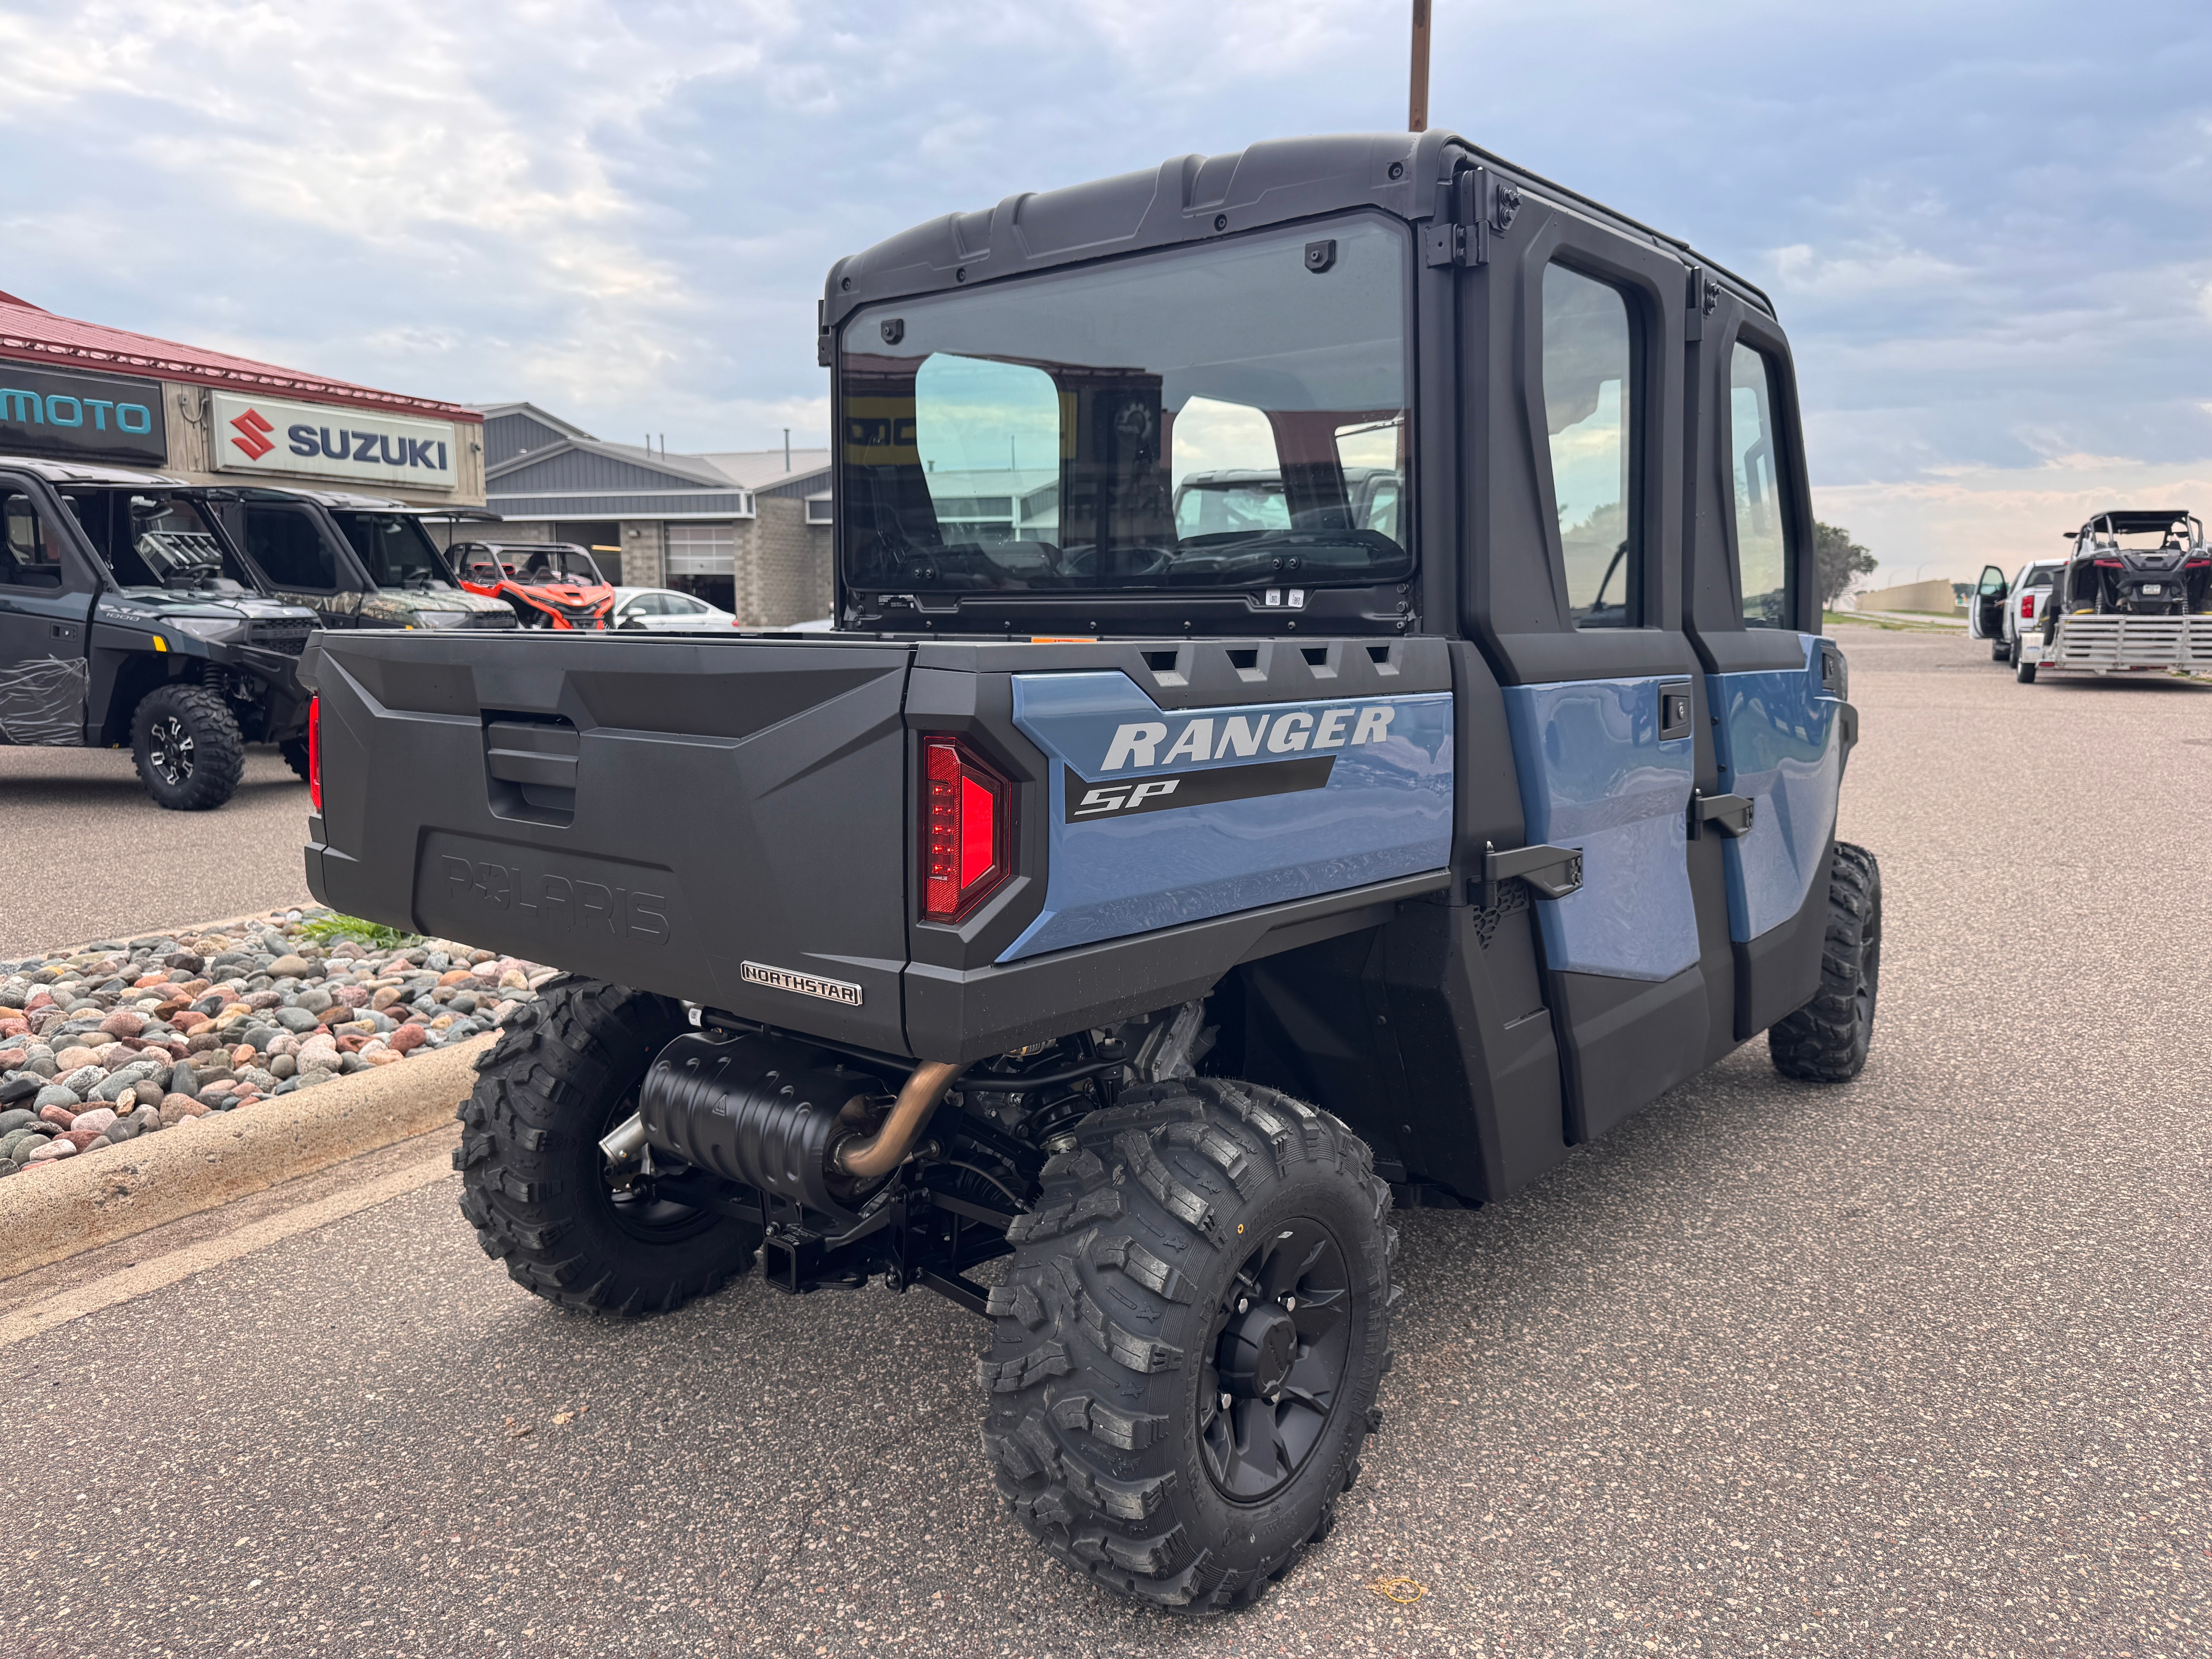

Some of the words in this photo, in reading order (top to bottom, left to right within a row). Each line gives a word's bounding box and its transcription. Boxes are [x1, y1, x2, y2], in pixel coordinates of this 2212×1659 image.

[0, 388, 151, 434] MOTO
[288, 424, 447, 471] SUZUKI
[106, 612, 140, 622] 1000
[1100, 706, 1395, 771] RANGER
[1074, 779, 1180, 816] SP
[441, 855, 670, 945] POLARIS
[746, 967, 854, 1001] NORTHSTAR
